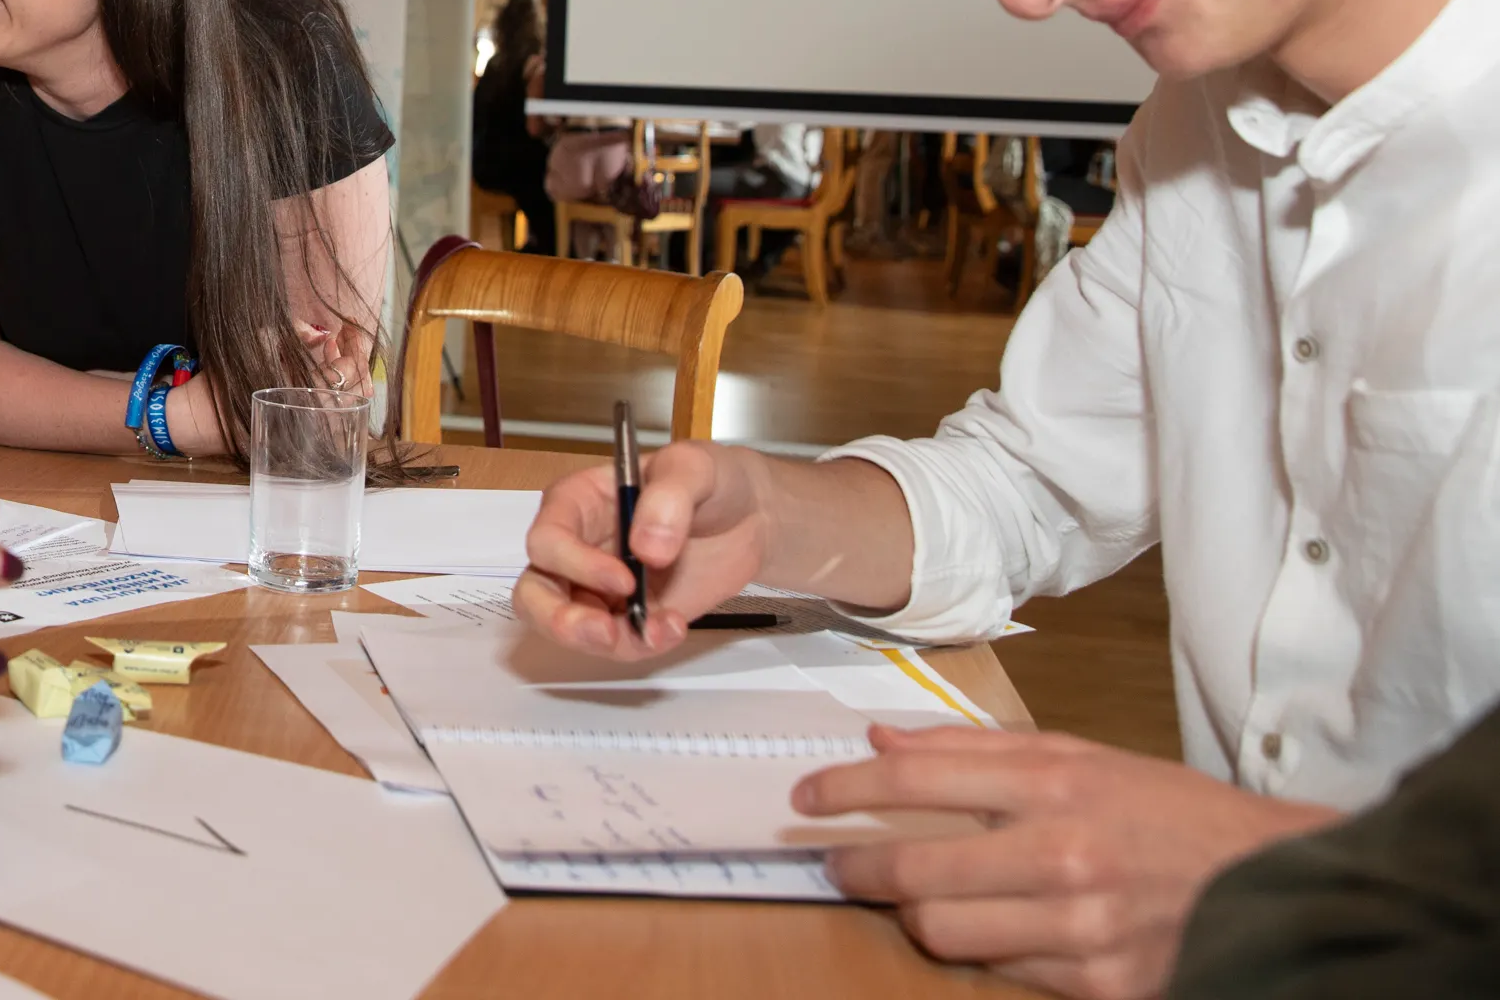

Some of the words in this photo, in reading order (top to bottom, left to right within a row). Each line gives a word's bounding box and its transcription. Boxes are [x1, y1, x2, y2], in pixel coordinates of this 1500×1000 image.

[37, 568, 165, 597] MAZOWIECKIM?
[150, 578, 190, 592] JAKA
[66, 588, 148, 607] KULTURA
